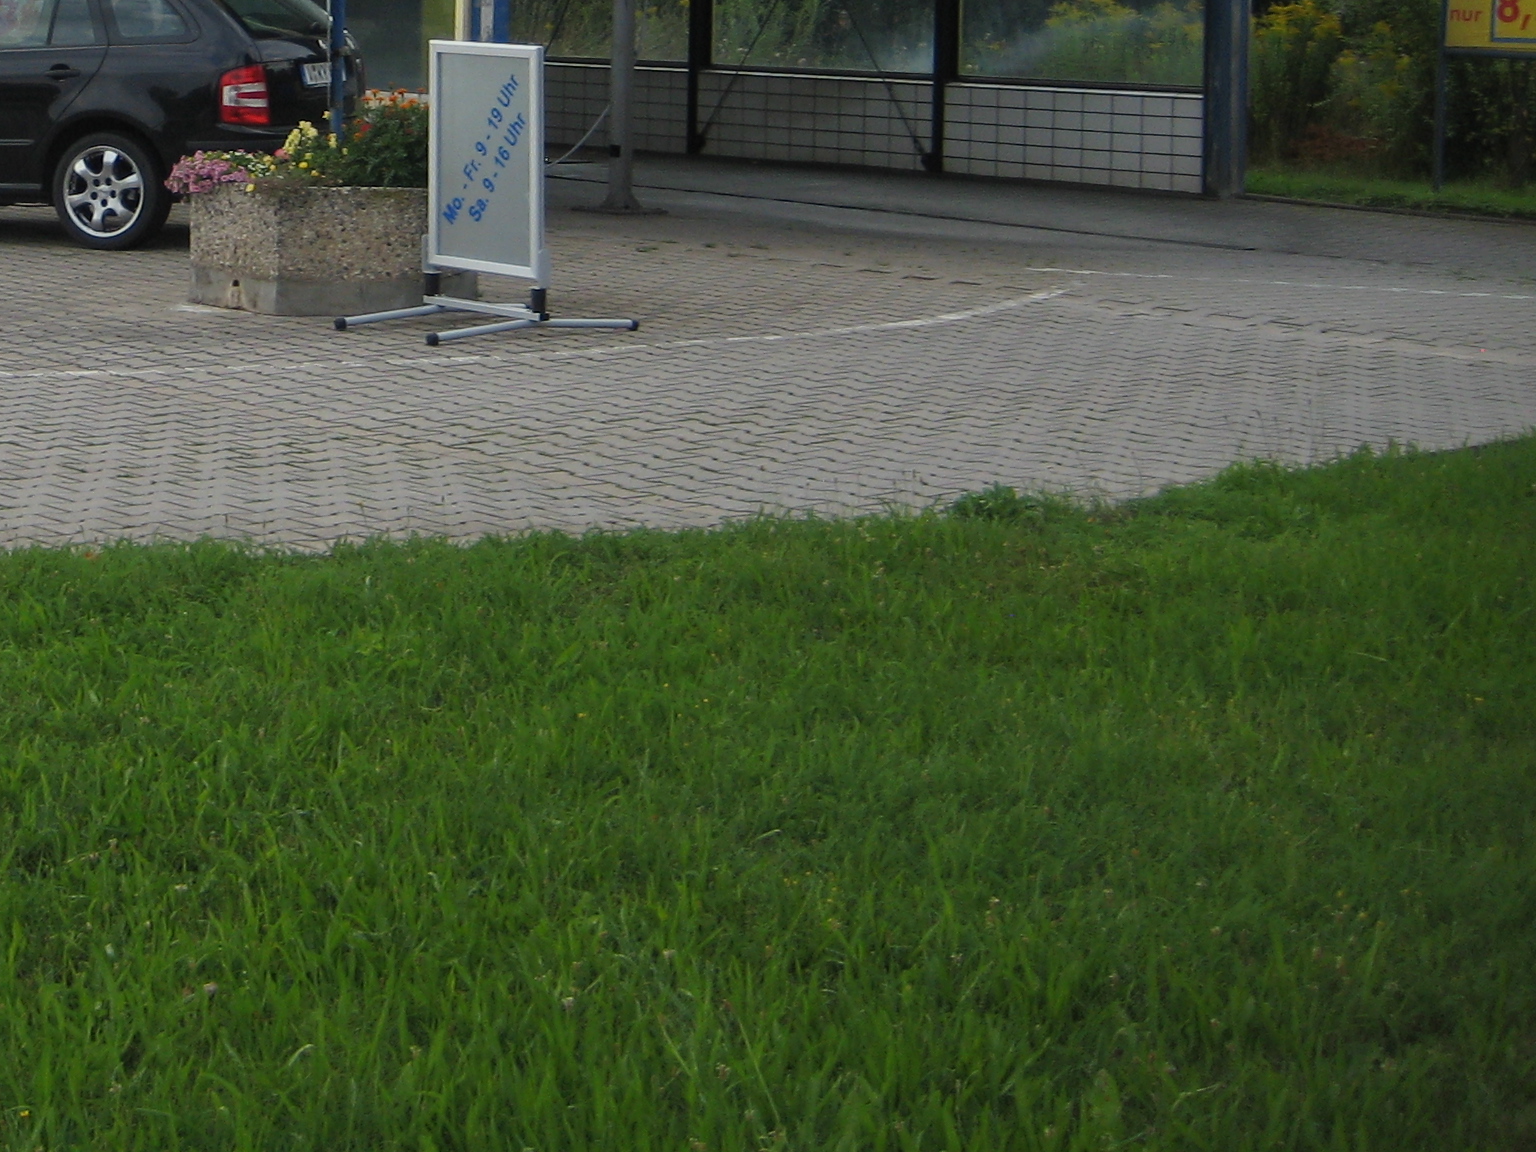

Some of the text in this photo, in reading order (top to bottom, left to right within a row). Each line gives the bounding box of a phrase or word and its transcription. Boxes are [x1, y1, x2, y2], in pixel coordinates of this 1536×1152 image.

[1449, 8, 1482, 22] nur
[442, 197, 465, 225] Mo.
[463, 159, 482, 181] Fr.
[475, 141, 488, 157] 9
[487, 107, 503, 130] 19
[497, 74, 520, 108] Uhr
[468, 198, 489, 223] Sa.
[482, 177, 495, 193] 9
[493, 146, 511, 168] 16
[504, 112, 527, 147] Uhr
